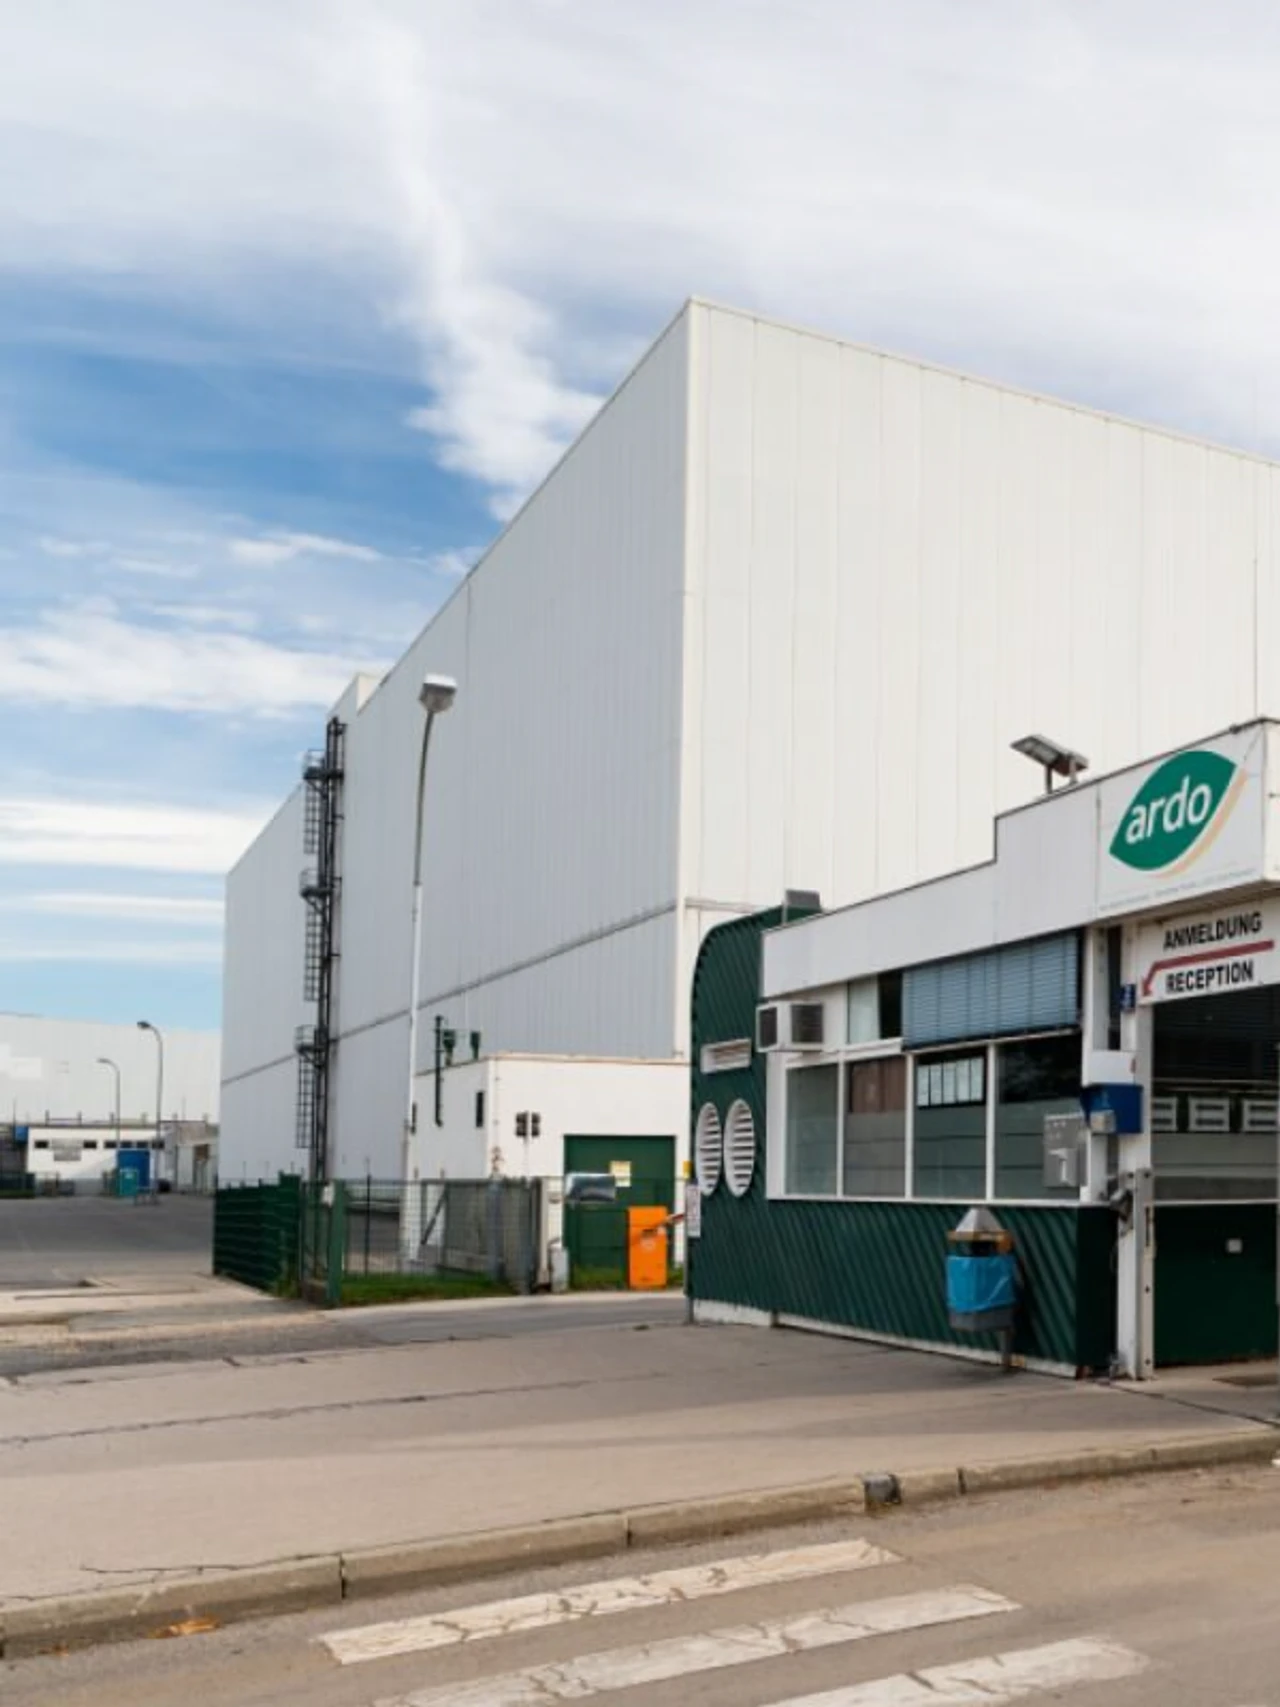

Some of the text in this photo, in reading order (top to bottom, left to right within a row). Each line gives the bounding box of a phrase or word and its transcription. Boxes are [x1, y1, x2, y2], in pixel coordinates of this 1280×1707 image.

[1124, 775, 1212, 844] ardo
[1163, 911, 1263, 950] ANMELDUNG
[1166, 960, 1254, 994] RECEPTION
